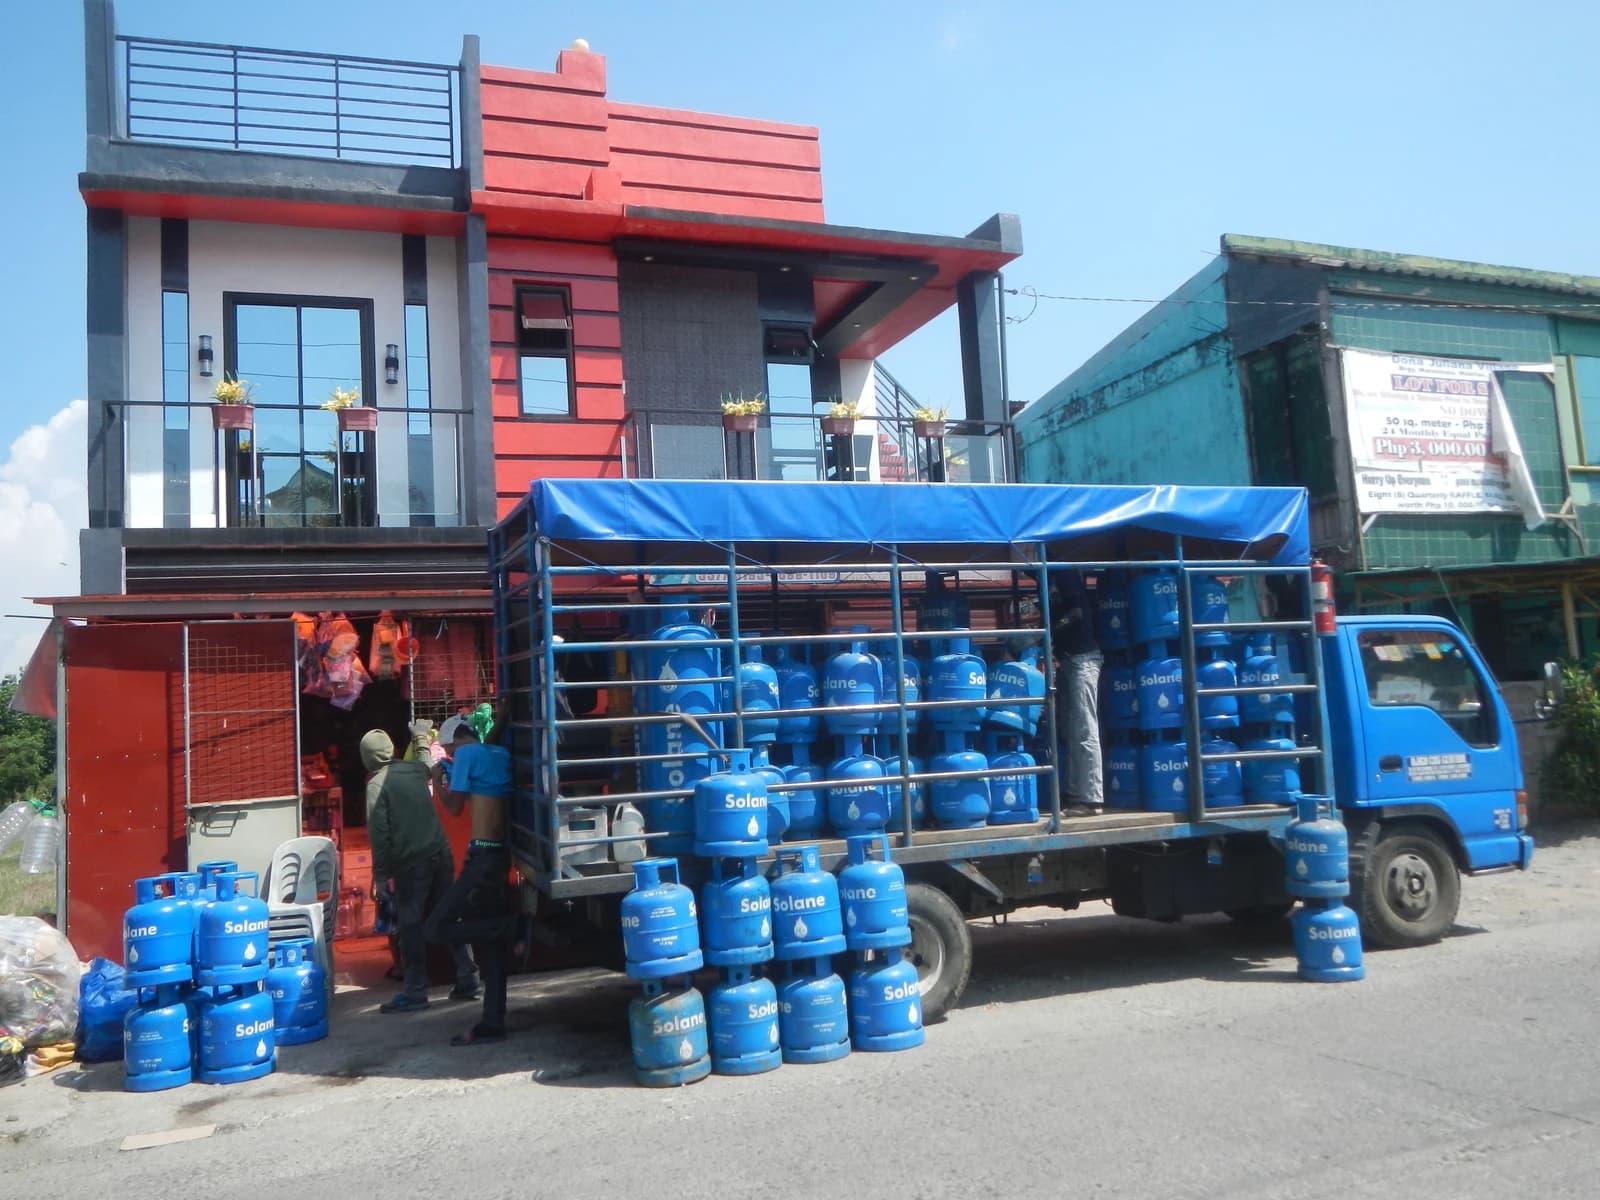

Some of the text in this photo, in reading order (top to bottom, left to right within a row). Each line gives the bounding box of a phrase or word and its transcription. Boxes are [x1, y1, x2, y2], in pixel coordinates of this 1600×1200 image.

[1421, 419, 1452, 428] meter
[1375, 438, 1409, 460] Php
[989, 669, 1027, 688] olane
[1153, 759, 1188, 772] Solan
[725, 792, 767, 809] Solan
[1286, 838, 1329, 853] olane
[740, 896, 772, 913] Sola
[772, 895, 826, 912] Solane
[235, 1017, 274, 1038] Solan
